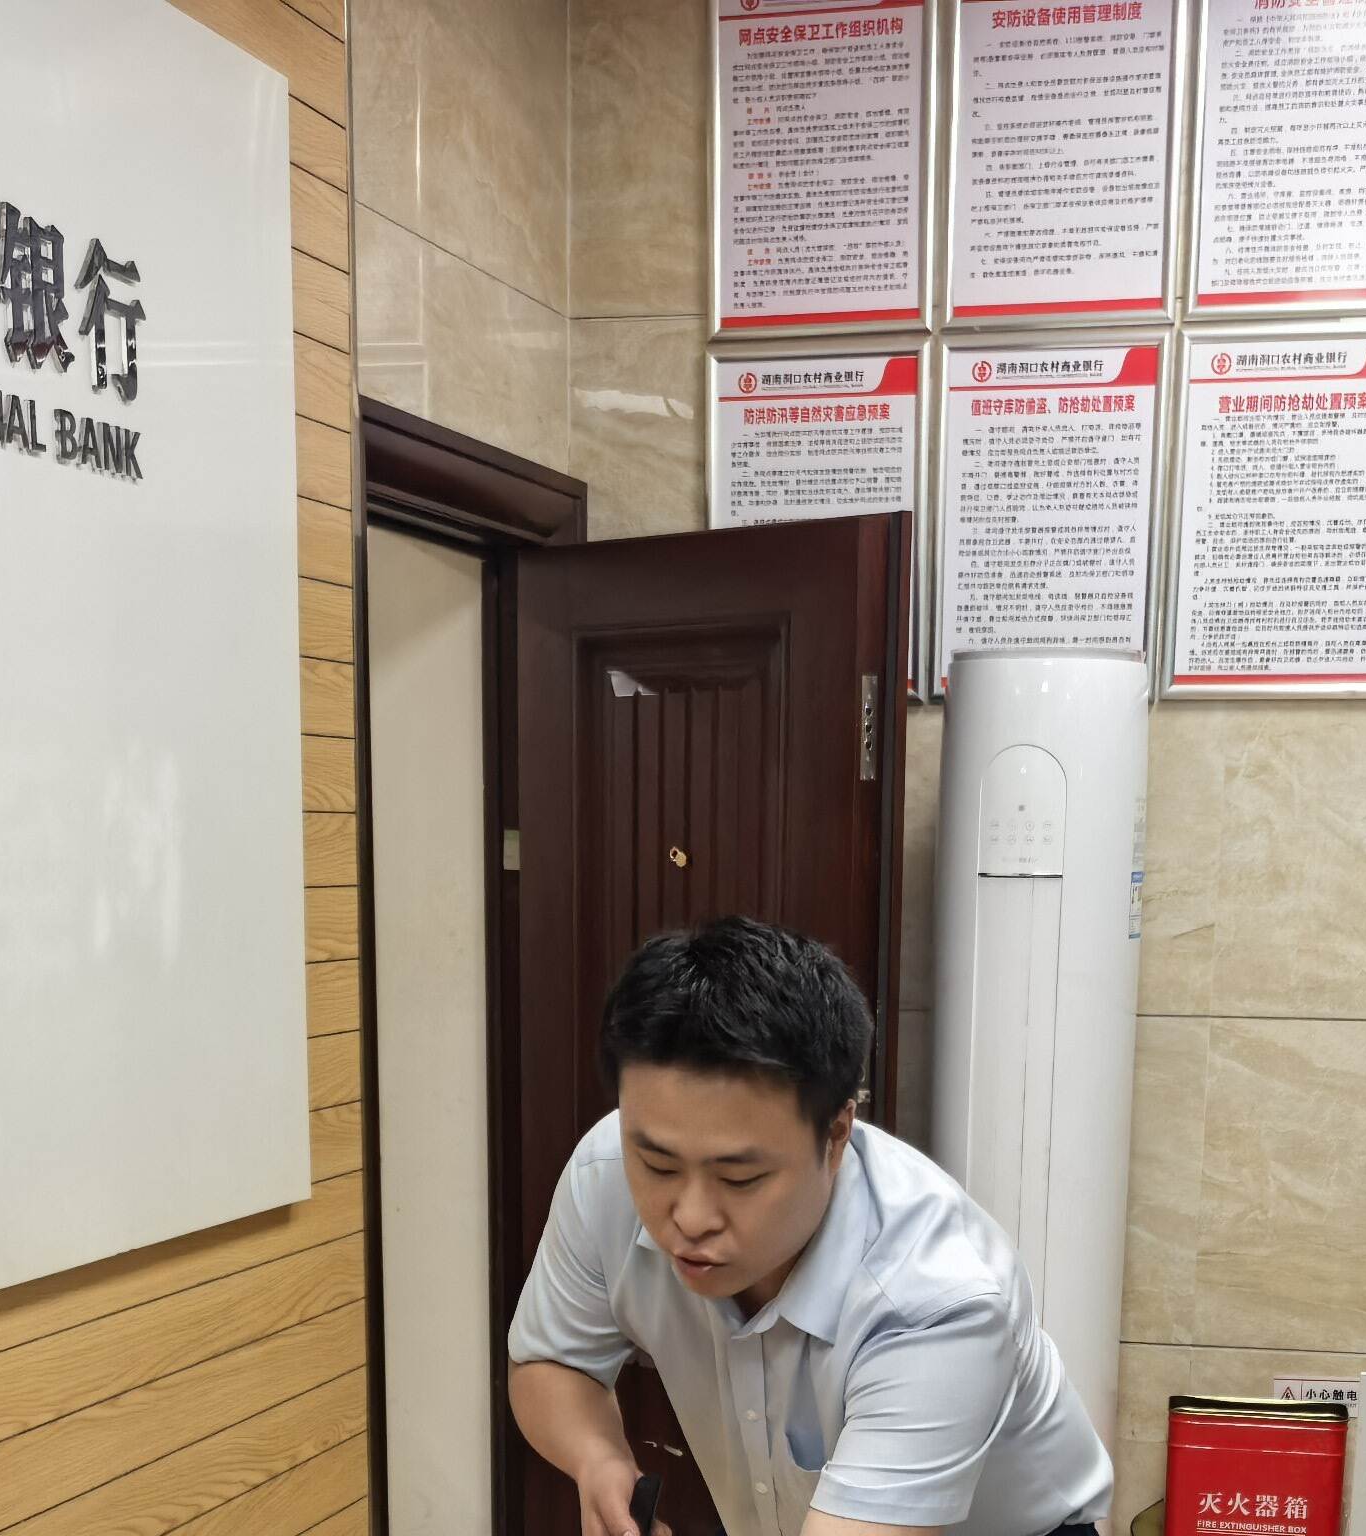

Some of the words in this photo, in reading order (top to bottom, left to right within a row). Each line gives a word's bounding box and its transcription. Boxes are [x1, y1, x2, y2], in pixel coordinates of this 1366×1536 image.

[991, 2, 1143, 28] 安防设备使用管理制度
[738, 17, 904, 46] 网点安全保卫工作组织机构
[995, 360, 1105, 374] 湖南洞口农村商业银行
[1236, 351, 1347, 367] 湖南洞口农村商业银行
[761, 370, 865, 385] 湖南洞口农村商业银行
[743, 403, 891, 425] 防洪防汛等自然灾害应急预案
[52, 408, 144, 480] BANK
[1305, 1388, 1357, 1401] 小心触电
[1195, 1491, 1308, 1520] 灭火器箱
[1197, 1519, 1217, 1529] FIRE
[1219, 1521, 1285, 1533] EXTINGUISHER
[1287, 1524, 1307, 1534] BOX
